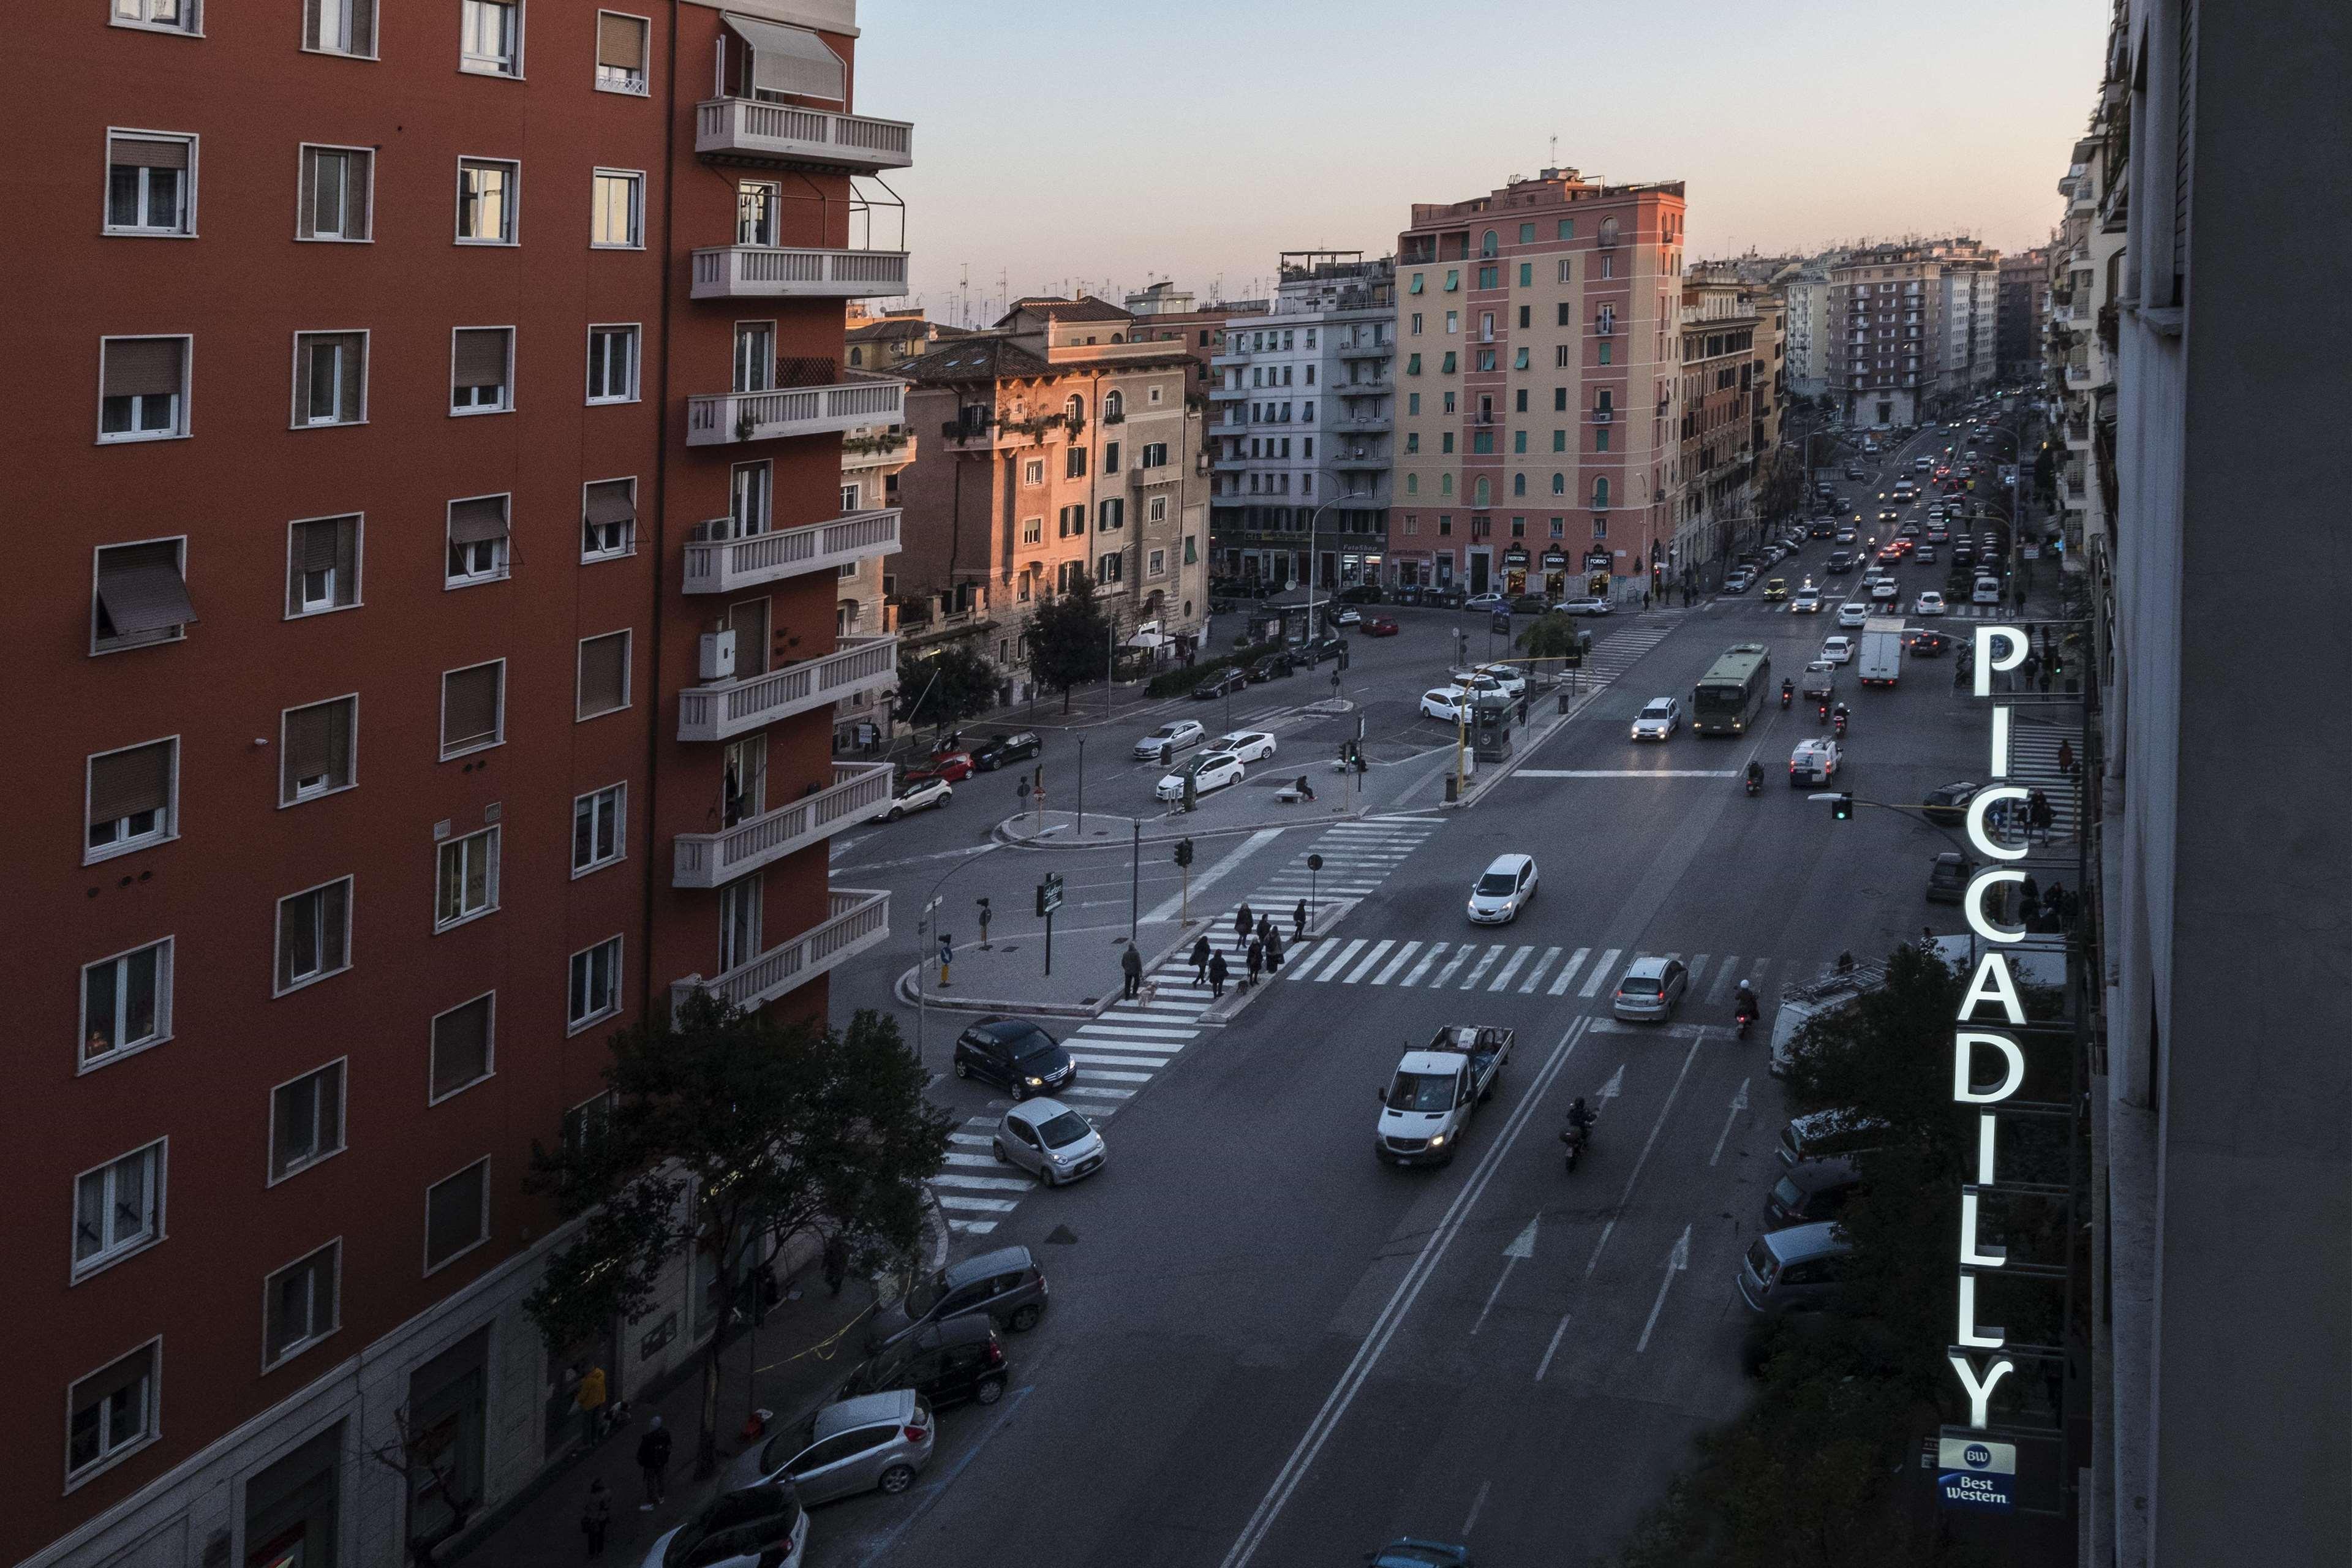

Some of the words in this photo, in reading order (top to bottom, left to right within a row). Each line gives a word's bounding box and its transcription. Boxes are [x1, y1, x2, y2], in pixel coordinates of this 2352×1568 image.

[1950, 626, 2029, 1428] PICCADILLY
[1966, 1450, 1988, 1463] BW
[1961, 1476, 1993, 1491] Best
[1947, 1487, 2006, 1503] Western
